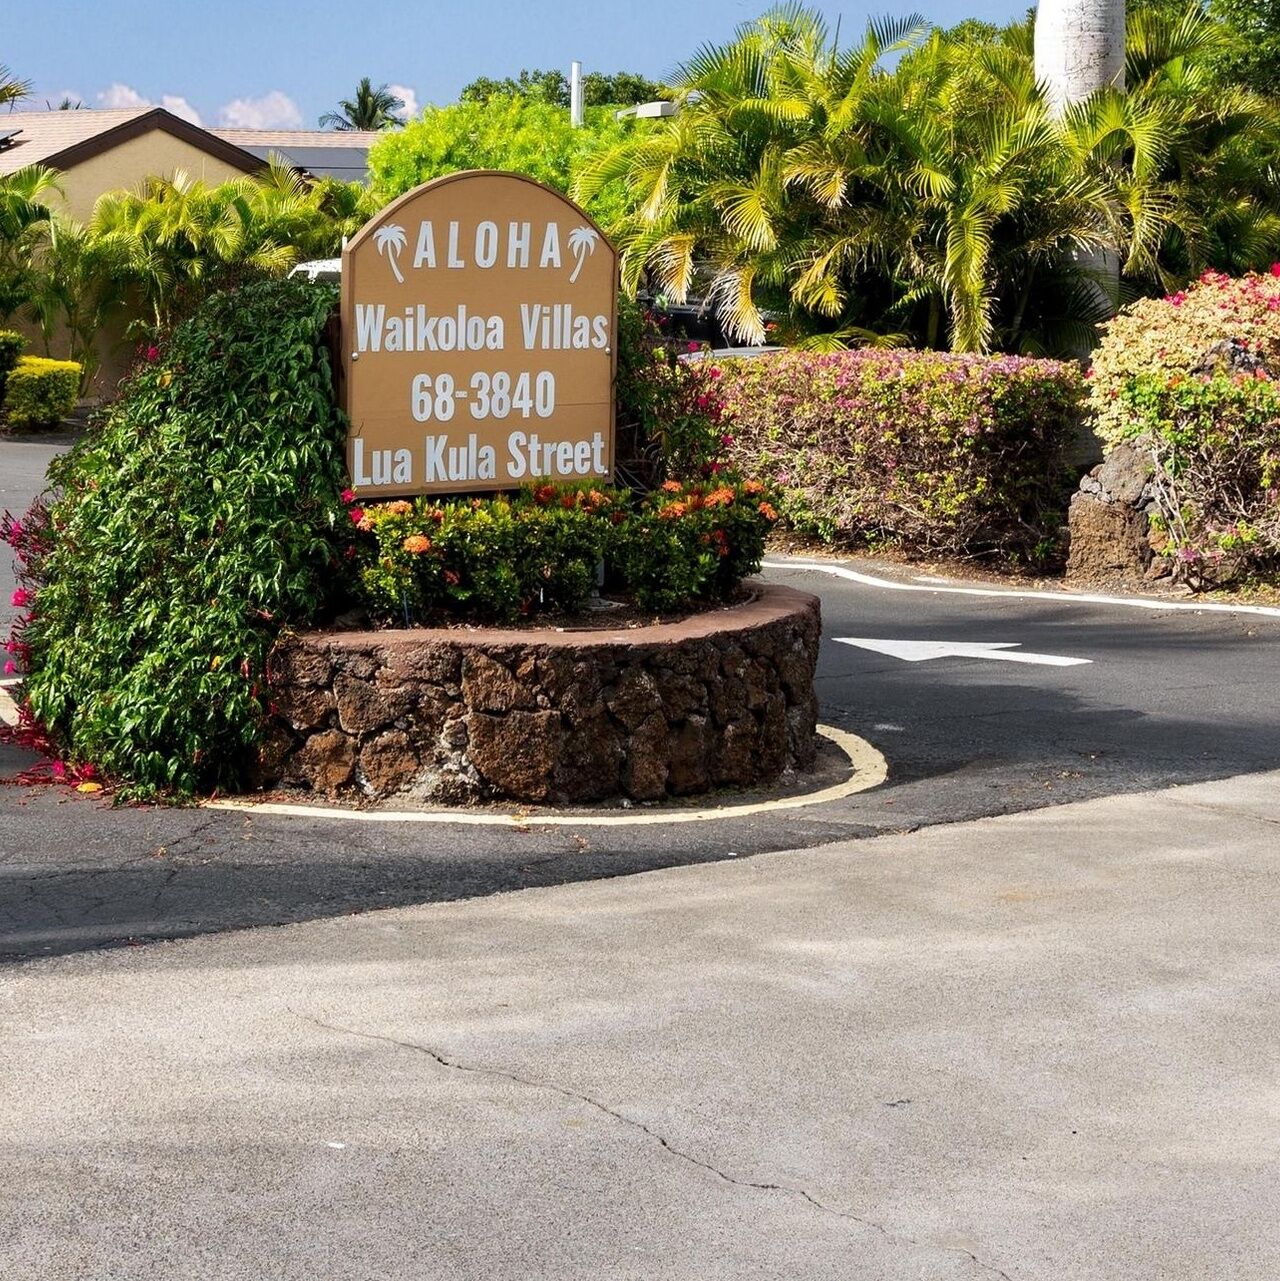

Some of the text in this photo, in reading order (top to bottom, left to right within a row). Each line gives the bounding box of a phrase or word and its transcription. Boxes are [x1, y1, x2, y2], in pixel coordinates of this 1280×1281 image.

[413, 221, 561, 268] ALOHA
[355, 303, 608, 352] Waikoloa Villas
[411, 371, 555, 422] 68-3840
[353, 431, 605, 486] Lua Kula Street
